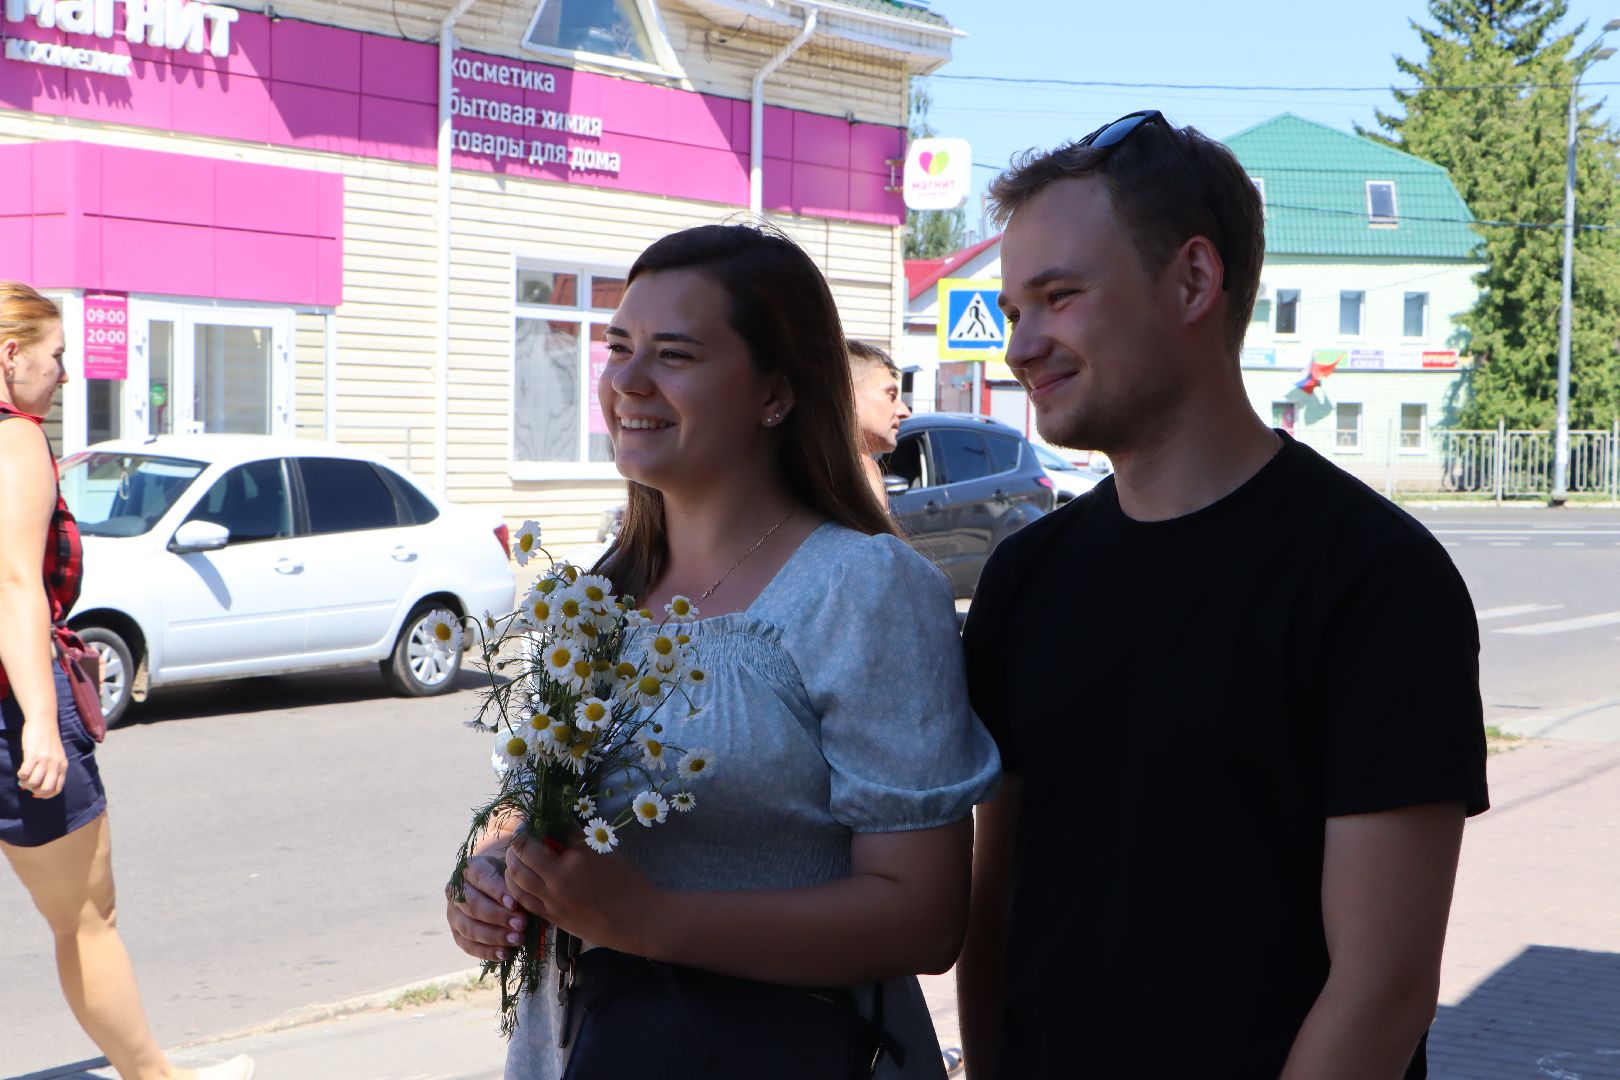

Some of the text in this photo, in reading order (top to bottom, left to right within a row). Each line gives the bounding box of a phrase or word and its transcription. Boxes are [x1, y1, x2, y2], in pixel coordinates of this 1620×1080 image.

[450, 57, 556, 94] косметика
[450, 87, 603, 138] бытовая химия
[450, 127, 621, 173] товары для дома
